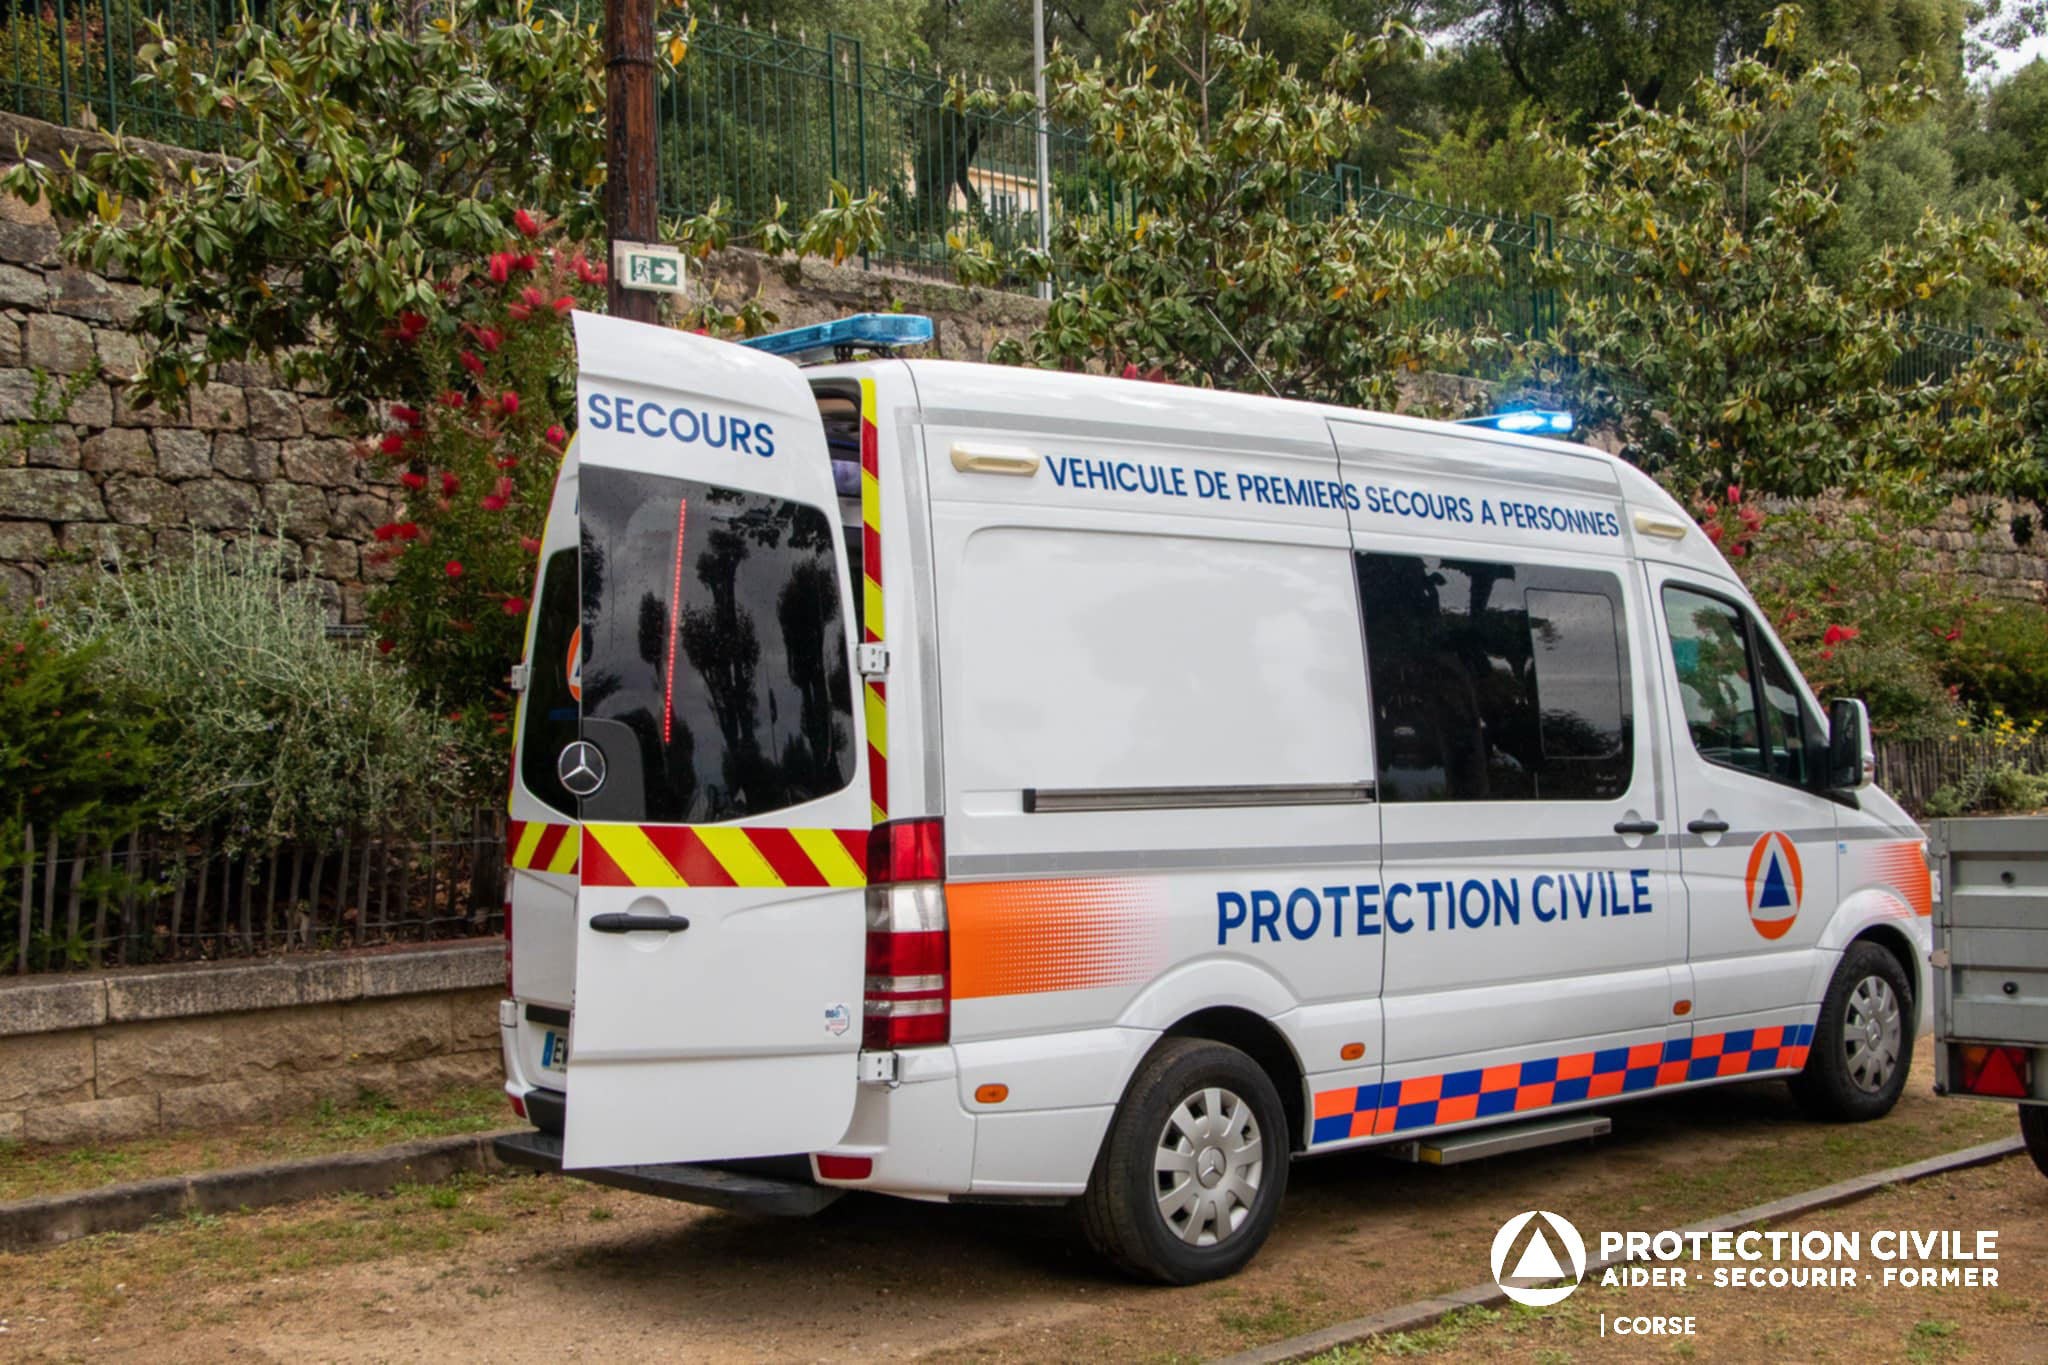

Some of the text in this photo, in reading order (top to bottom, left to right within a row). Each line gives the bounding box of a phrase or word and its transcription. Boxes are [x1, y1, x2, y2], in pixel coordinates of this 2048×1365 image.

[588, 393, 776, 459] SECOURS
[1045, 455, 1621, 538] VEHICULE DE PREMIERS SECOURS A PERSONNES
[1216, 867, 1655, 946] PROTECTION CIVILE
